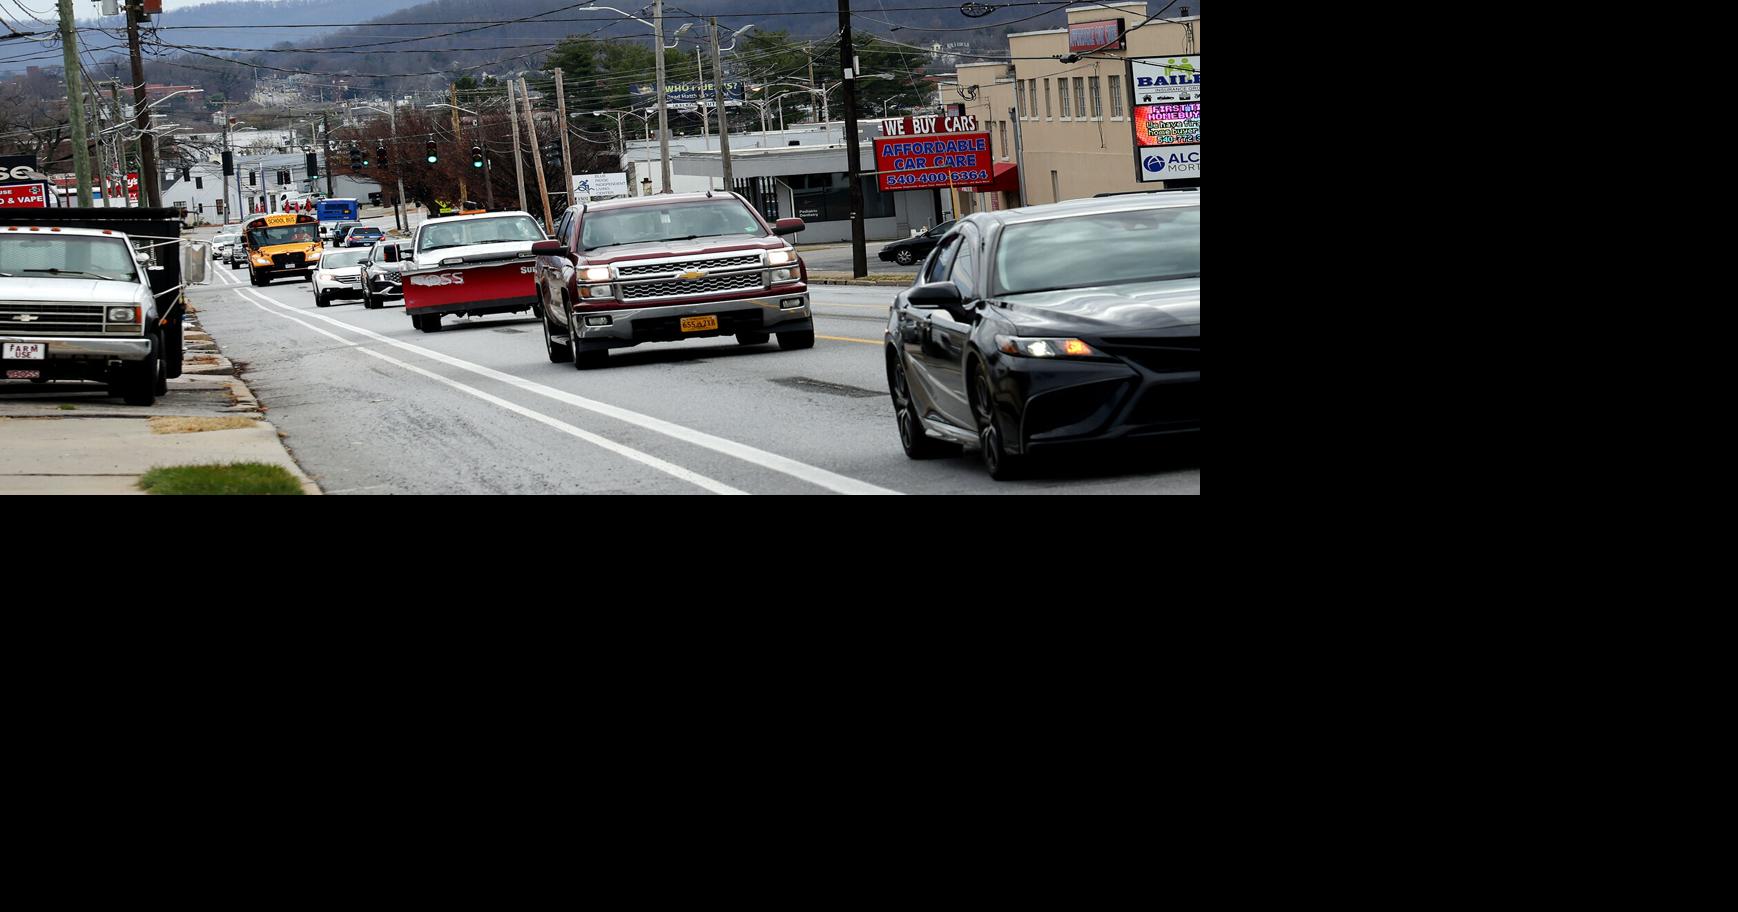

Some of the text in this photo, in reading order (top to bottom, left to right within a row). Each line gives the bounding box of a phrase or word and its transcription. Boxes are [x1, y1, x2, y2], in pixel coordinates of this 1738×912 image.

[664, 84, 688, 93] WHO
[885, 115, 976, 136] WE BUY CARS
[882, 138, 986, 157] AFFORDABLE
[894, 154, 977, 171] CAR CARE
[1168, 152, 1200, 164] ALC
[887, 170, 988, 185] 540-400-6364
[17, 195, 43, 203] VAPE
[411, 271, 464, 286] OSS
[9, 344, 39, 352] FARM
[15, 351, 32, 359] USE
